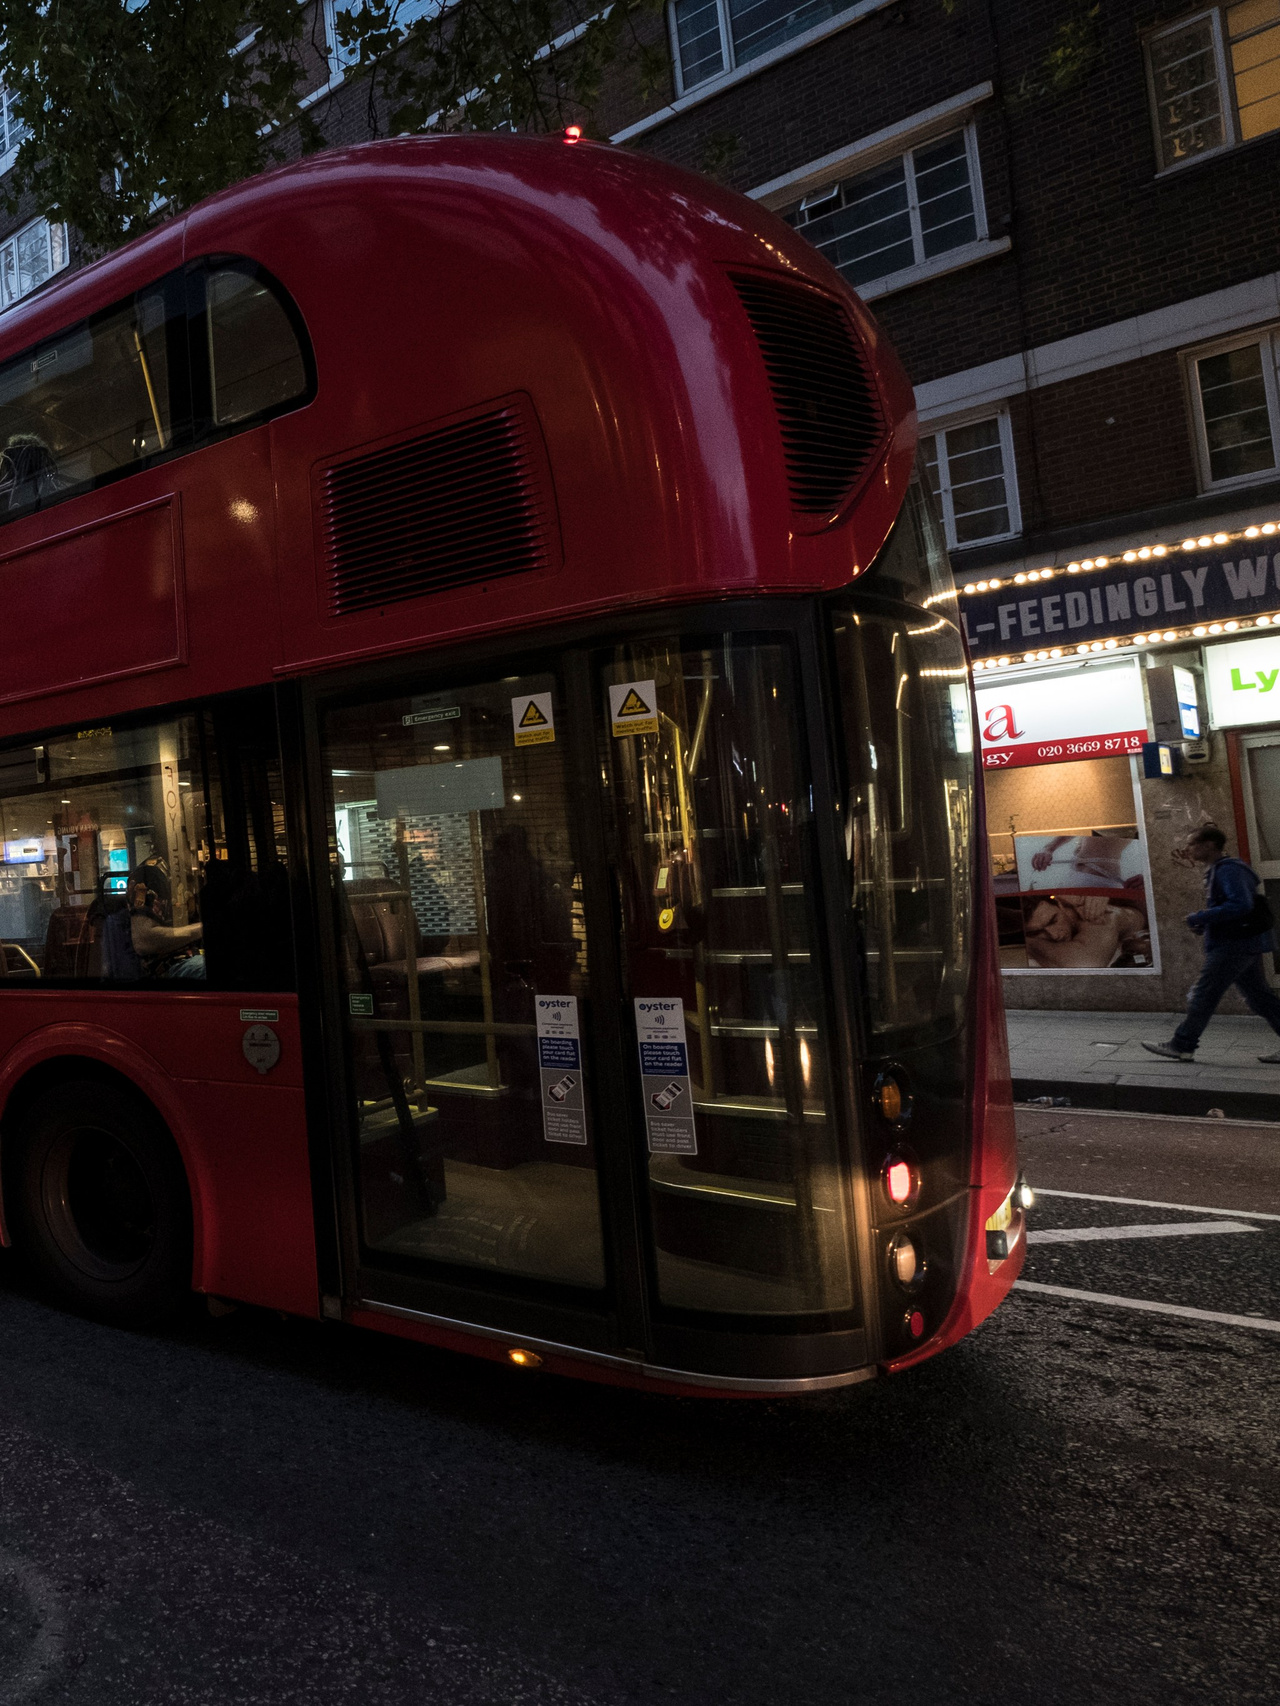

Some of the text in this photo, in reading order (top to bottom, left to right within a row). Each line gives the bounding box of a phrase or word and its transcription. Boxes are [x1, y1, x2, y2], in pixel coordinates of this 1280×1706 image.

[1223, 552, 1280, 601] W
[414, 711, 444, 722] Emergency
[983, 704, 1025, 742] a
[1037, 736, 1140, 757] 020 3669 8718
[539, 999, 571, 1009] oyster
[639, 1002, 676, 1012] oyster
